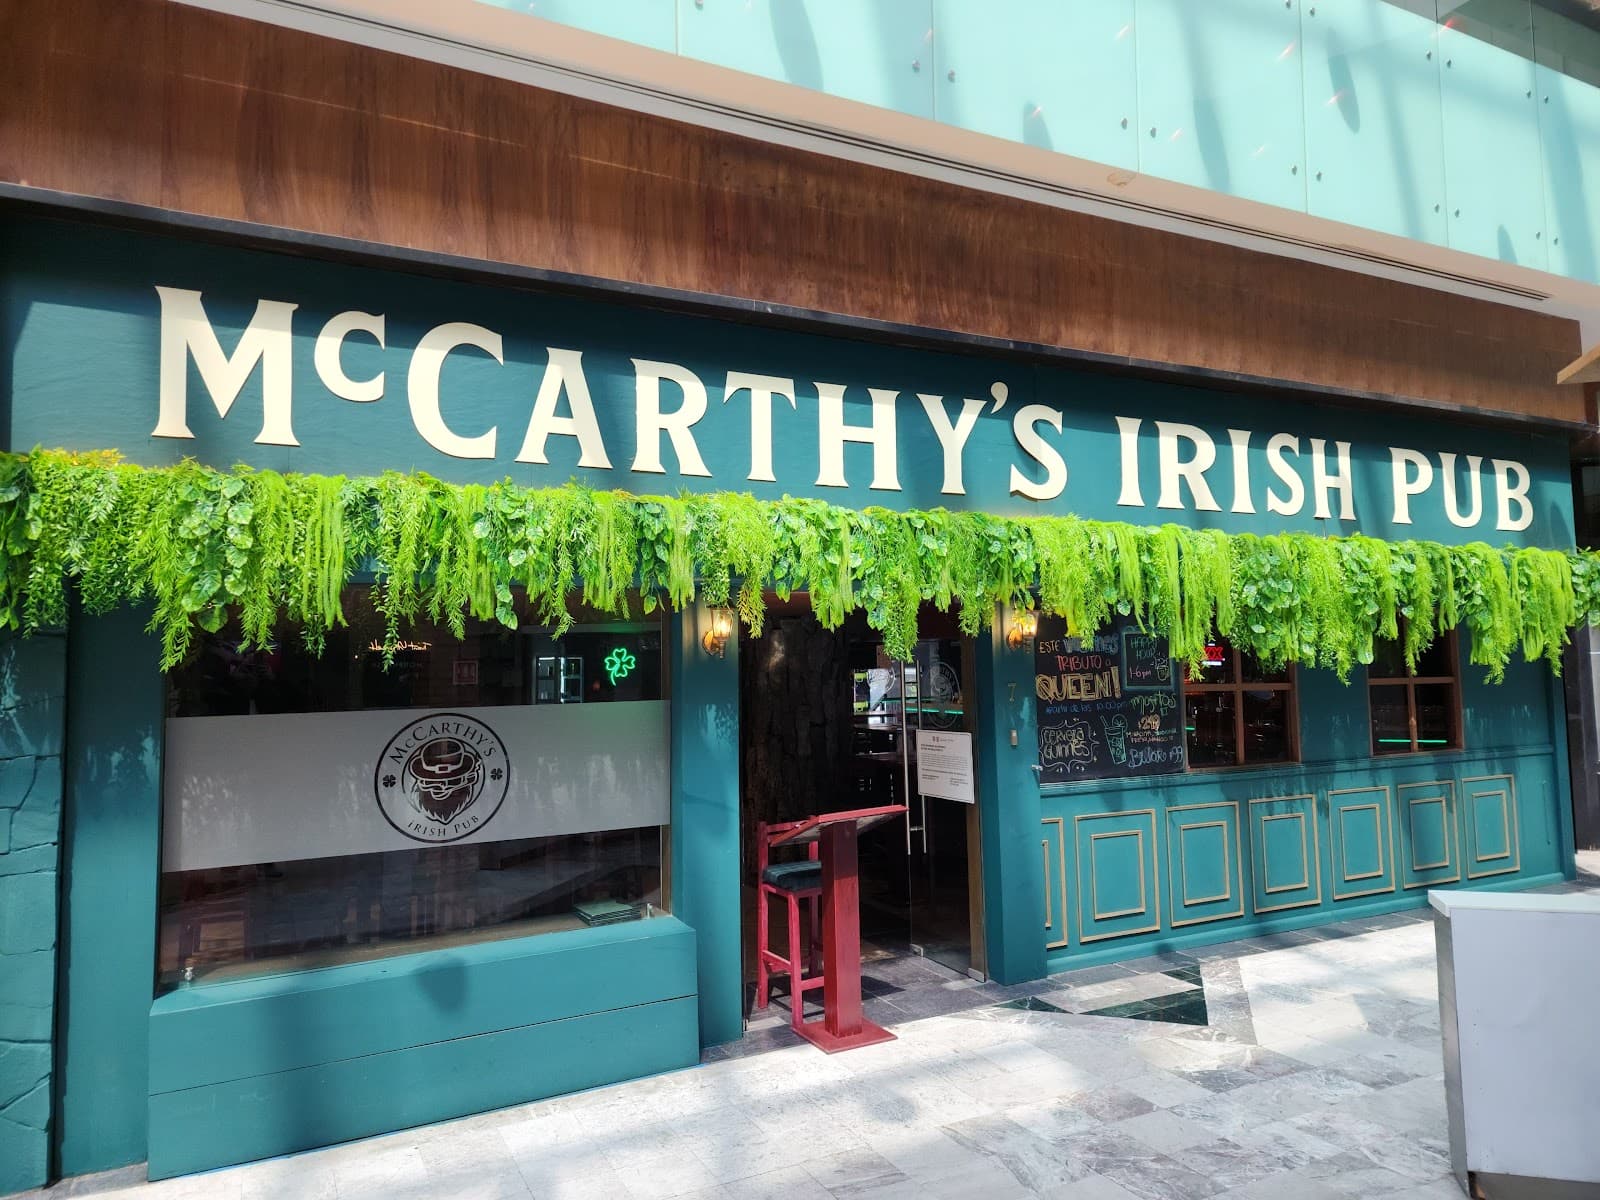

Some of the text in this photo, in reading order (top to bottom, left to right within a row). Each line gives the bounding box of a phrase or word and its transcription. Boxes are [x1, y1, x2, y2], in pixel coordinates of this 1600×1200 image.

[152, 285, 1534, 532] McCARTHY'S IRISH PUB
[1039, 639, 1060, 654] ESTE
[1055, 654, 1102, 671] TRIBUTO
[388, 722, 497, 765] McCARTHY'S
[407, 815, 480, 837] IRISH PUB
